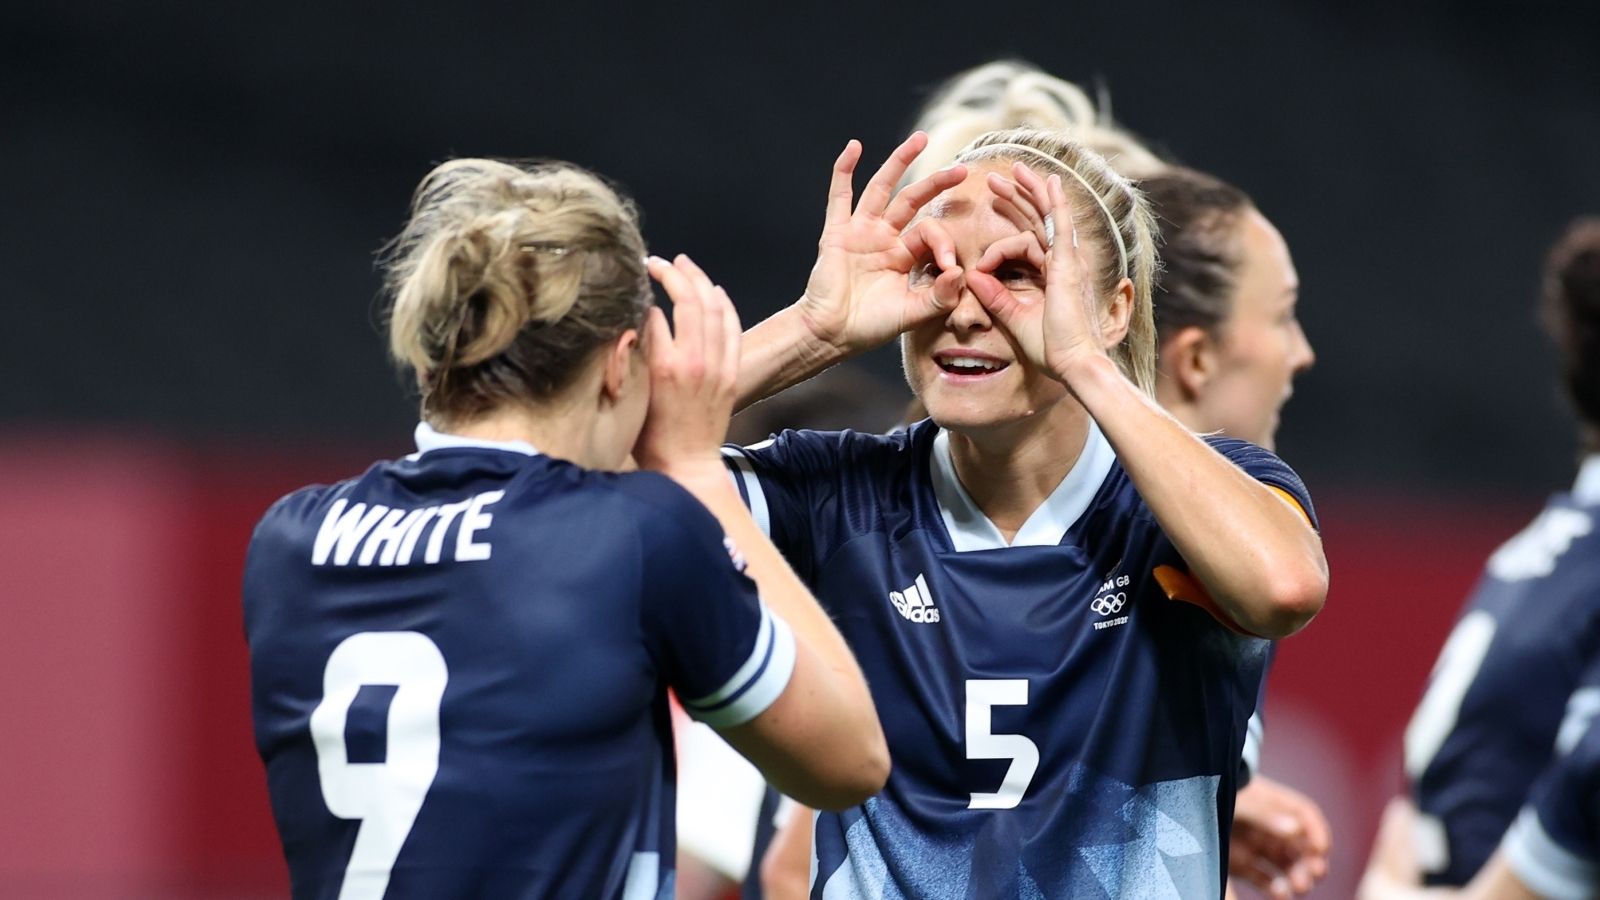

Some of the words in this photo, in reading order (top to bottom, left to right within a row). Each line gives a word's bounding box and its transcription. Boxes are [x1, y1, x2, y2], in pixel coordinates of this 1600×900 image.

[311, 489, 506, 567] WHITE
[889, 591, 941, 624] adidas
[1094, 579, 1115, 598] AM
[1116, 575, 1130, 587] GB
[1093, 619, 1114, 630] TOKYO
[309, 630, 449, 900] 9
[965, 679, 1040, 810] 5
